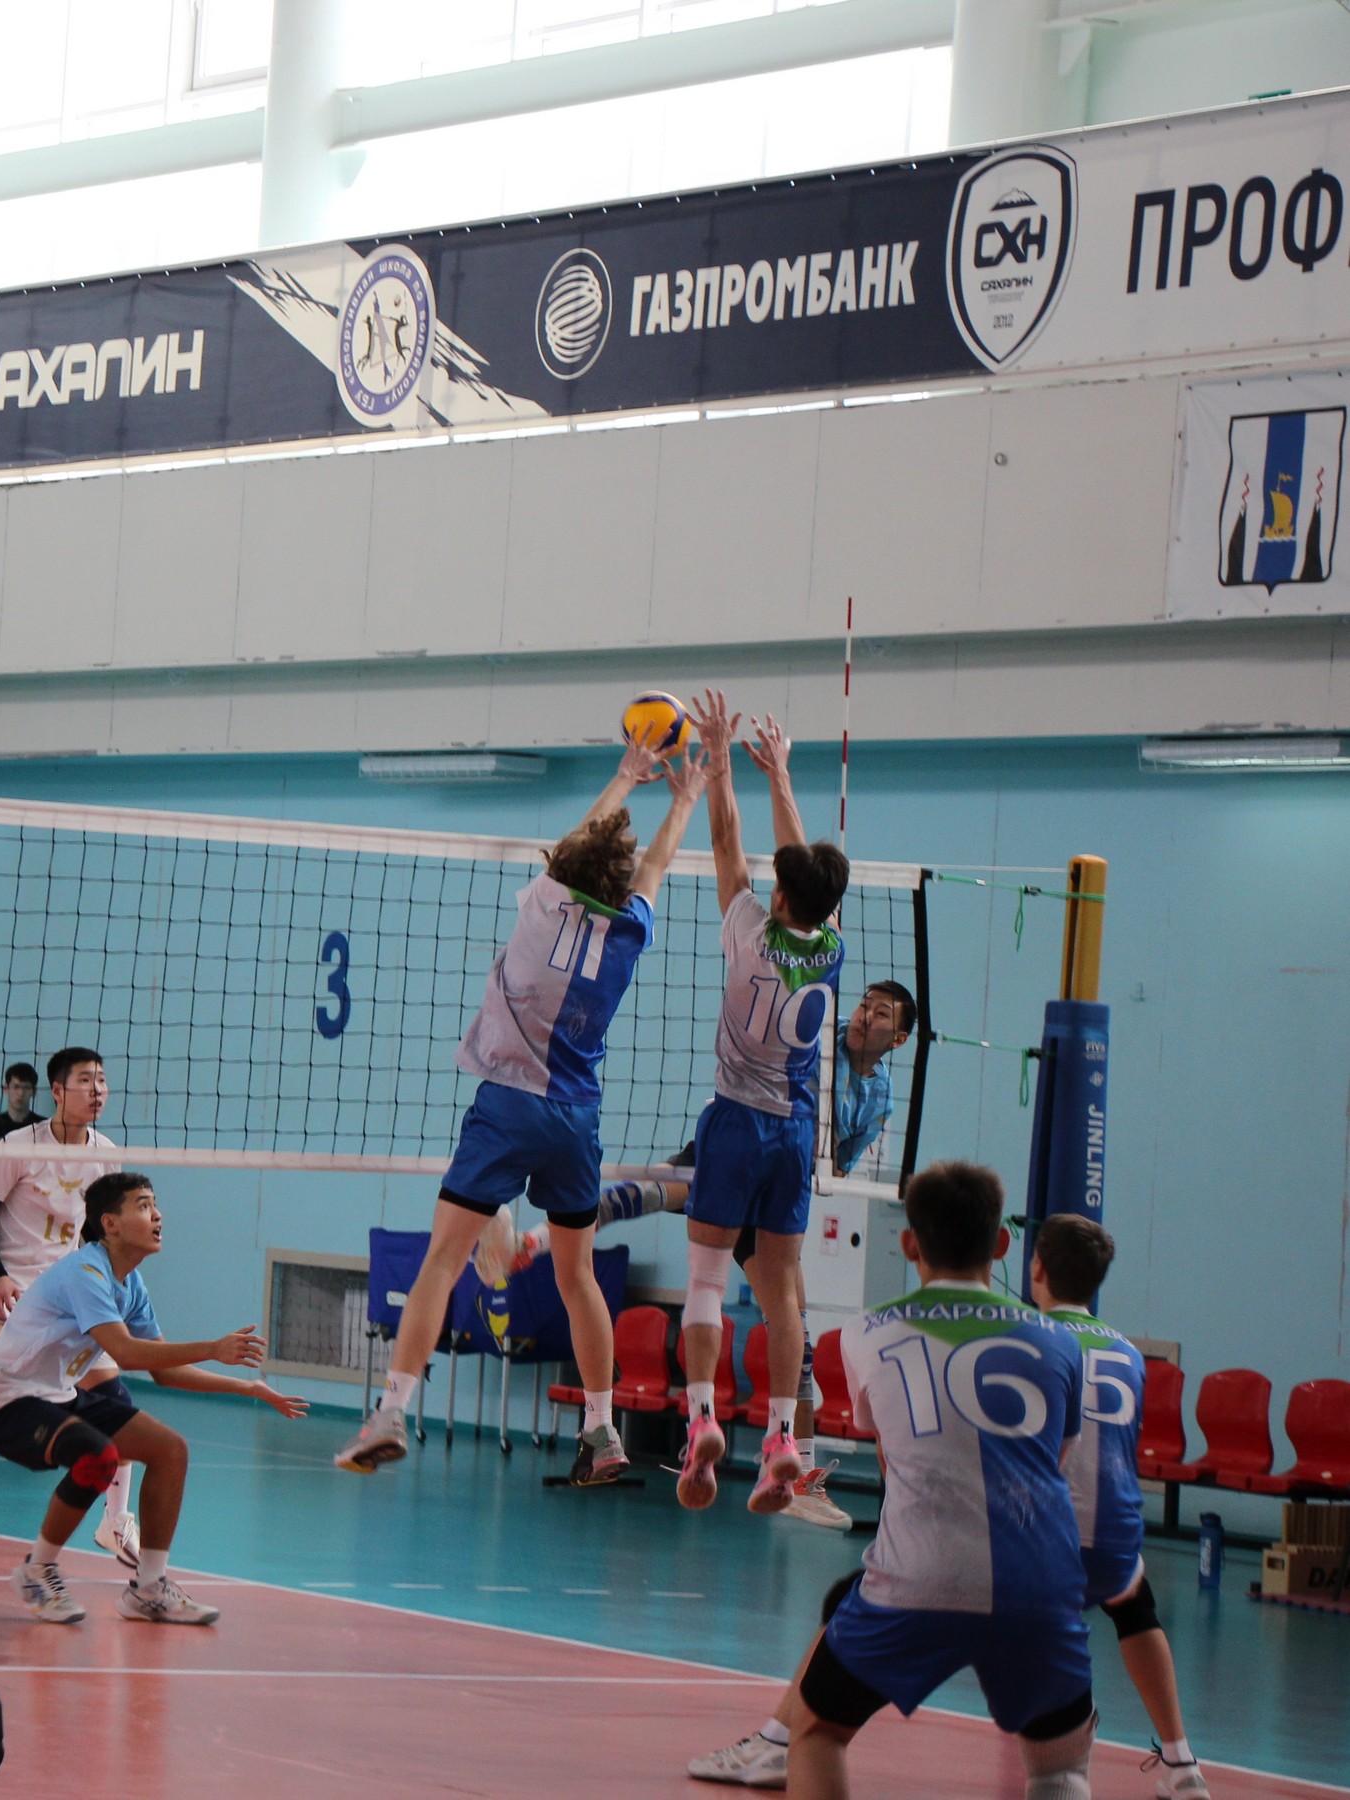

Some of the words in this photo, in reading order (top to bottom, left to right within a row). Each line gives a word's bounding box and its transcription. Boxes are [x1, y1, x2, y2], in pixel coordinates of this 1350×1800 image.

[1126, 167, 1350, 295] ПРОФ
[630, 240, 919, 338] ГАЗПРОМБАНК
[316, 931, 351, 1040] 3
[548, 902, 611, 981] 11
[744, 974, 834, 1050] 10
[1084, 1103, 1105, 1208] JINLING
[879, 1334, 1047, 1438] 16
